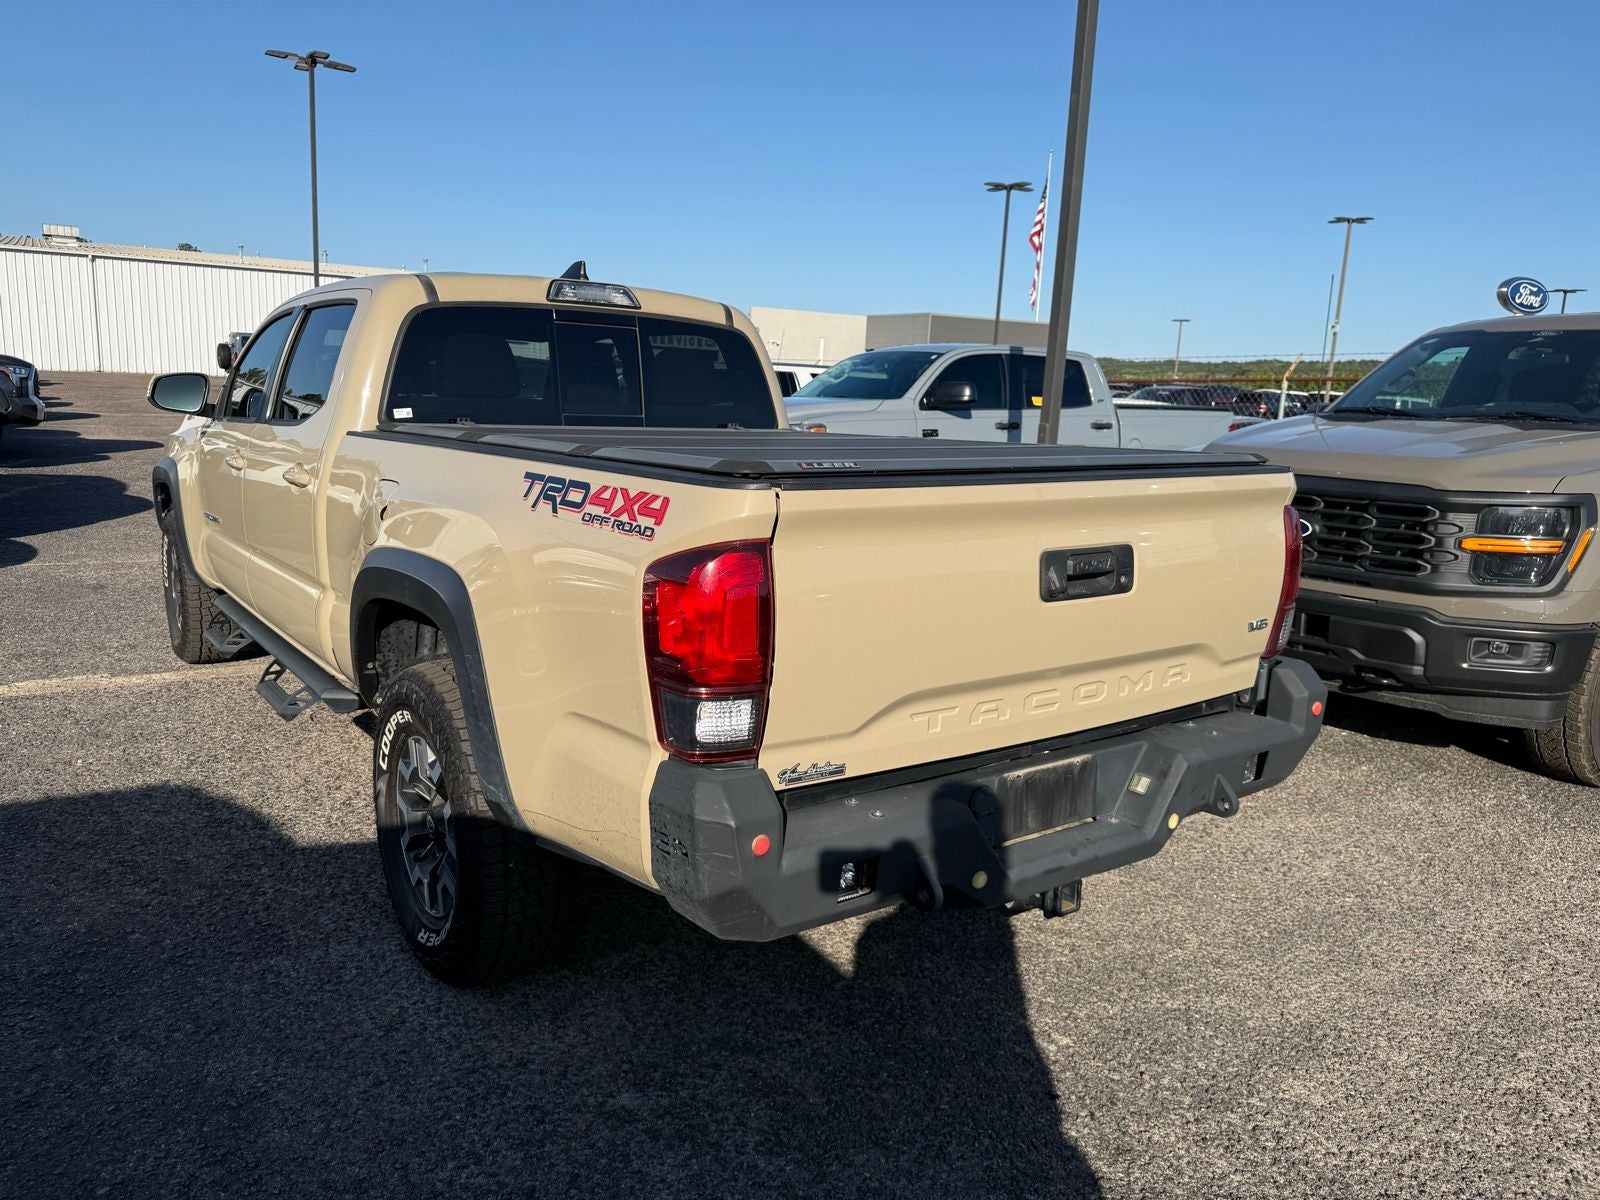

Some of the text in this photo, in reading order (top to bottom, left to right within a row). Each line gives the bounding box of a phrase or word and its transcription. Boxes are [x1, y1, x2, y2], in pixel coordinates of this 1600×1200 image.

[1515, 283, 1543, 308] Ford
[522, 471, 591, 518] TRD
[580, 512, 655, 542] OFF ROAD
[1248, 618, 1268, 632] V6
[910, 662, 1192, 734] TACOMA
[379, 710, 414, 771] COOPER
